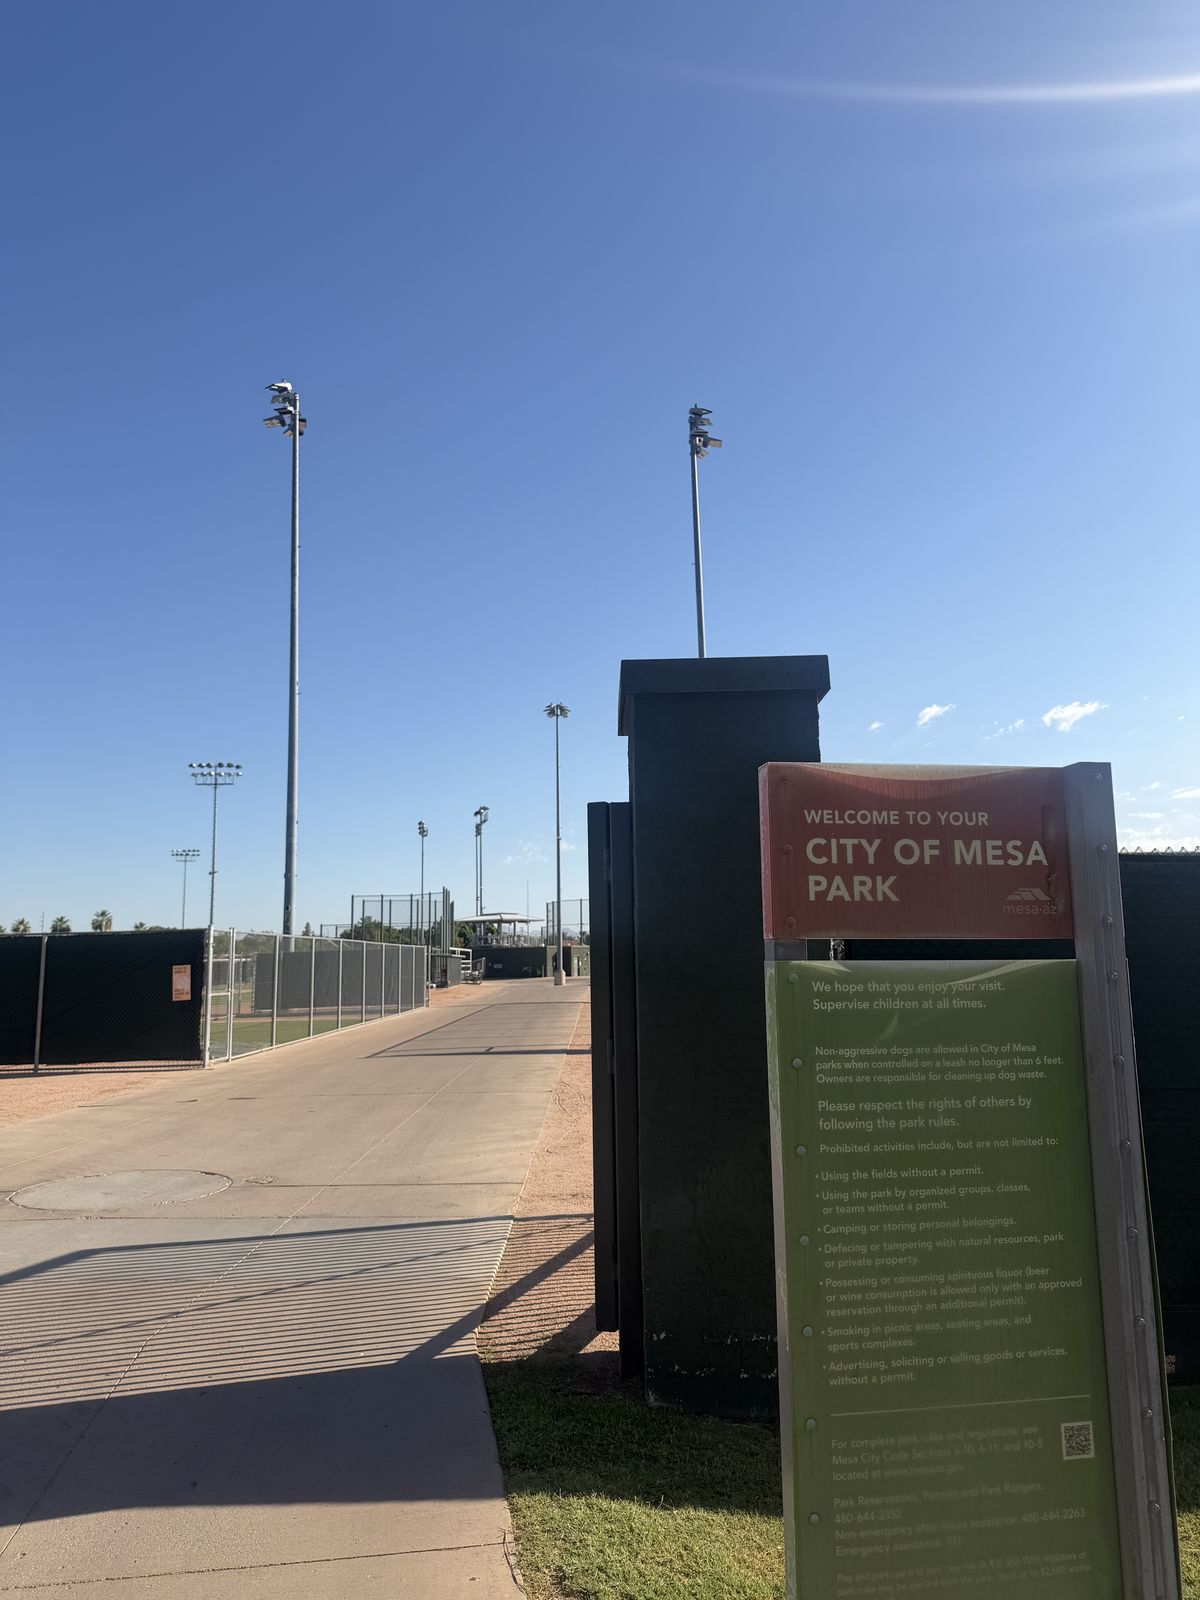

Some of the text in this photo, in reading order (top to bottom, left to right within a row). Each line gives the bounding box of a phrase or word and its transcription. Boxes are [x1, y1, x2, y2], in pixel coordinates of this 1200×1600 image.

[804, 810, 988, 826] WELCOME TO YOUR
[806, 838, 1048, 866] CITY OF MESA
[808, 874, 900, 901] PARK
[812, 980, 1004, 994] We hope that you enjoy your visit.
[813, 998, 985, 1013] Supervise children at all times.
[815, 1045, 887, 1058] Non-aggressive
[890, 1044, 912, 1057] dogs
[933, 1043, 967, 1054] allowed
[970, 1043, 978, 1053] in
[980, 1043, 998, 1055] City
[1001, 1043, 1010, 1052] of
[1013, 1042, 1036, 1052] Mesa
[815, 1059, 841, 1072] parks
[843, 1059, 869, 1069] when
[871, 1058, 918, 1068] controlled
[942, 1057, 966, 1067] leash
[968, 1059, 980, 1067] no
[981, 1056, 1011, 1068] longer
[1013, 1056, 1033, 1066] than
[1035, 1056, 1041, 1065] 6
[1043, 1055, 1064, 1065] feet.
[816, 1073, 852, 1083] Owners
[873, 1071, 925, 1084] responsible
[929, 1071, 940, 1081] for
[944, 1070, 981, 1083] cleaning
[984, 1072, 995, 1082] up
[998, 1069, 1015, 1081] dog
[1018, 1069, 1046, 1079] waste.
[818, 1095, 1031, 1113] Please respect the rights of others by
[819, 1116, 958, 1132] following the park rules.
[820, 1135, 1057, 1153] Prohibited activities include, but are not limited to:
[820, 1170, 849, 1183] Using
[851, 1169, 868, 1180] the
[871, 1168, 898, 1179] fields
[899, 1166, 938, 1178] without
[949, 1165, 984, 1178] permit.
[822, 1182, 1030, 1202] Using the park by organized groups, classes,
[822, 1199, 950, 1215] or teams without a permit.
[823, 1215, 1015, 1236] Camping or storing personal belongings.
[824, 1242, 867, 1256] Defacing
[883, 1238, 932, 1253] tampering
[935, 1237, 955, 1248] with
[959, 1235, 991, 1247] natural
[994, 1235, 1040, 1246] resources,
[1043, 1232, 1063, 1245] park
[824, 1254, 919, 1270] or private property.
[826, 1265, 1048, 1290] Possessing or consuming spirituous liquor (beer
[825, 1277, 1082, 1302] or wine consumption is allowed only with an approved
[826, 1295, 1026, 1317] reservation through an additional permit).
[827, 1324, 869, 1339] Smoking
[872, 1323, 881, 1334] in
[883, 1322, 912, 1335] picnic
[945, 1318, 981, 1332] seating
[1013, 1315, 1031, 1326] and
[828, 1337, 915, 1353] sports complexes.
[829, 1346, 1067, 1373] Advertising, soliciting or selling goods or services.
[828, 1371, 917, 1386] without a permit.
[831, 1438, 847, 1450] For
[832, 1452, 858, 1464] Mesa
[860, 1450, 880, 1464] City
[832, 1468, 868, 1481] located
